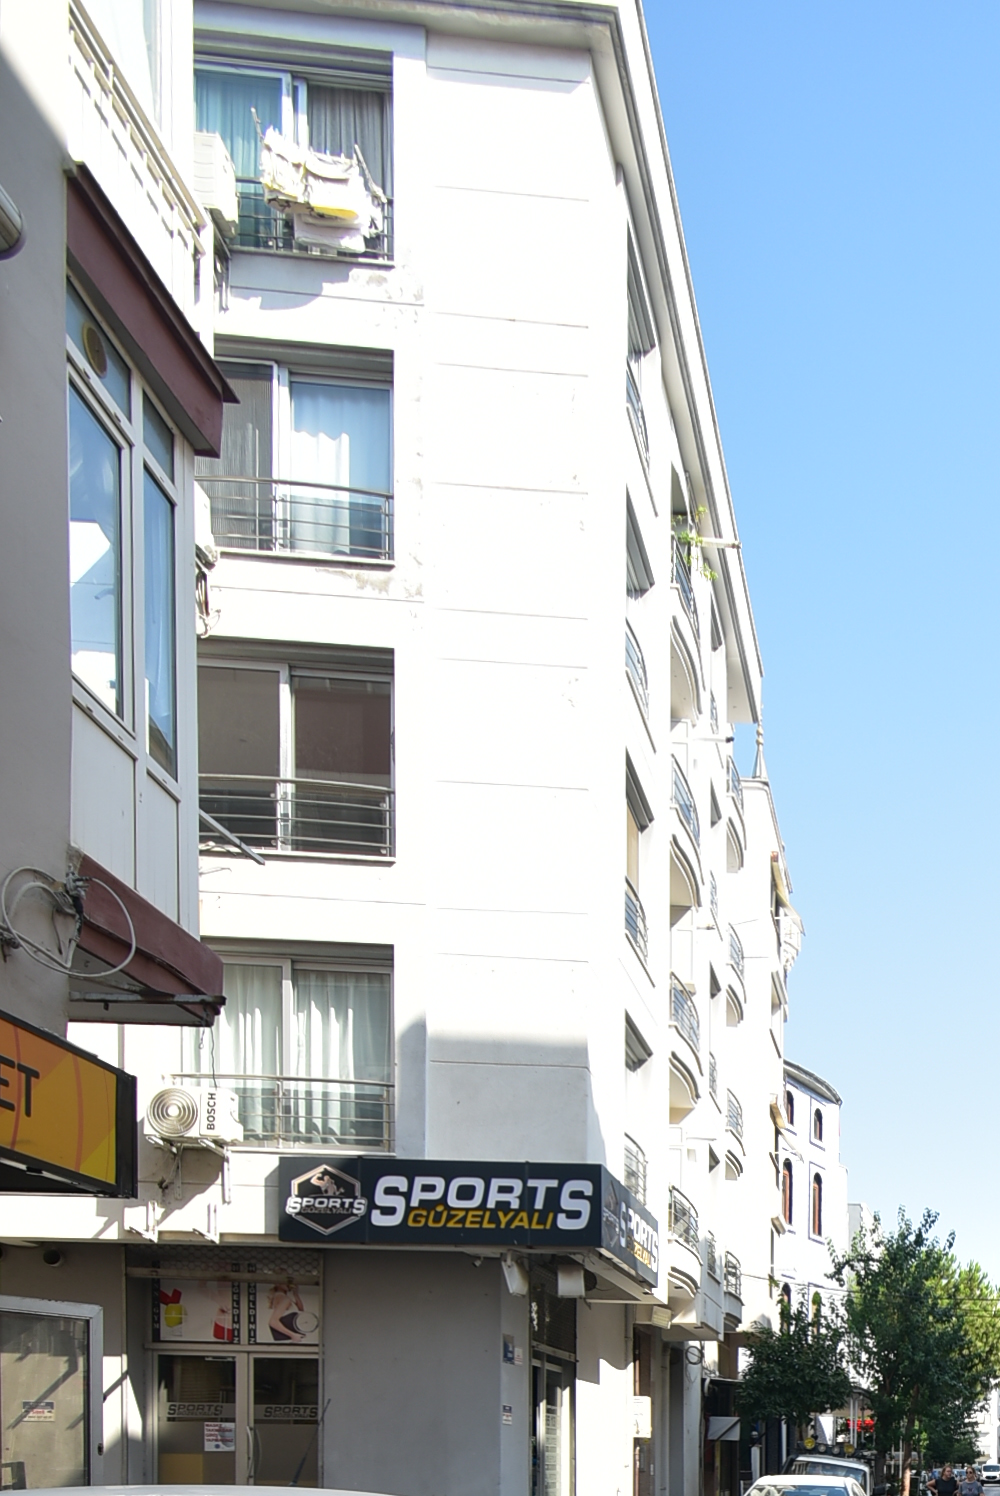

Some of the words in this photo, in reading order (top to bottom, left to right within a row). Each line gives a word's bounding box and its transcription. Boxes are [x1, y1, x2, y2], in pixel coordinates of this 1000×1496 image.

[206, 1092, 216, 1131] BOSCH
[285, 1197, 367, 1215] SPORTS
[370, 1175, 593, 1230] SPORTS
[407, 1204, 554, 1230] GÜZELYALI
[619, 1201, 659, 1273] SPORTS
[167, 1404, 223, 1416] SPORTS
[264, 1406, 318, 1418] SPORTS
